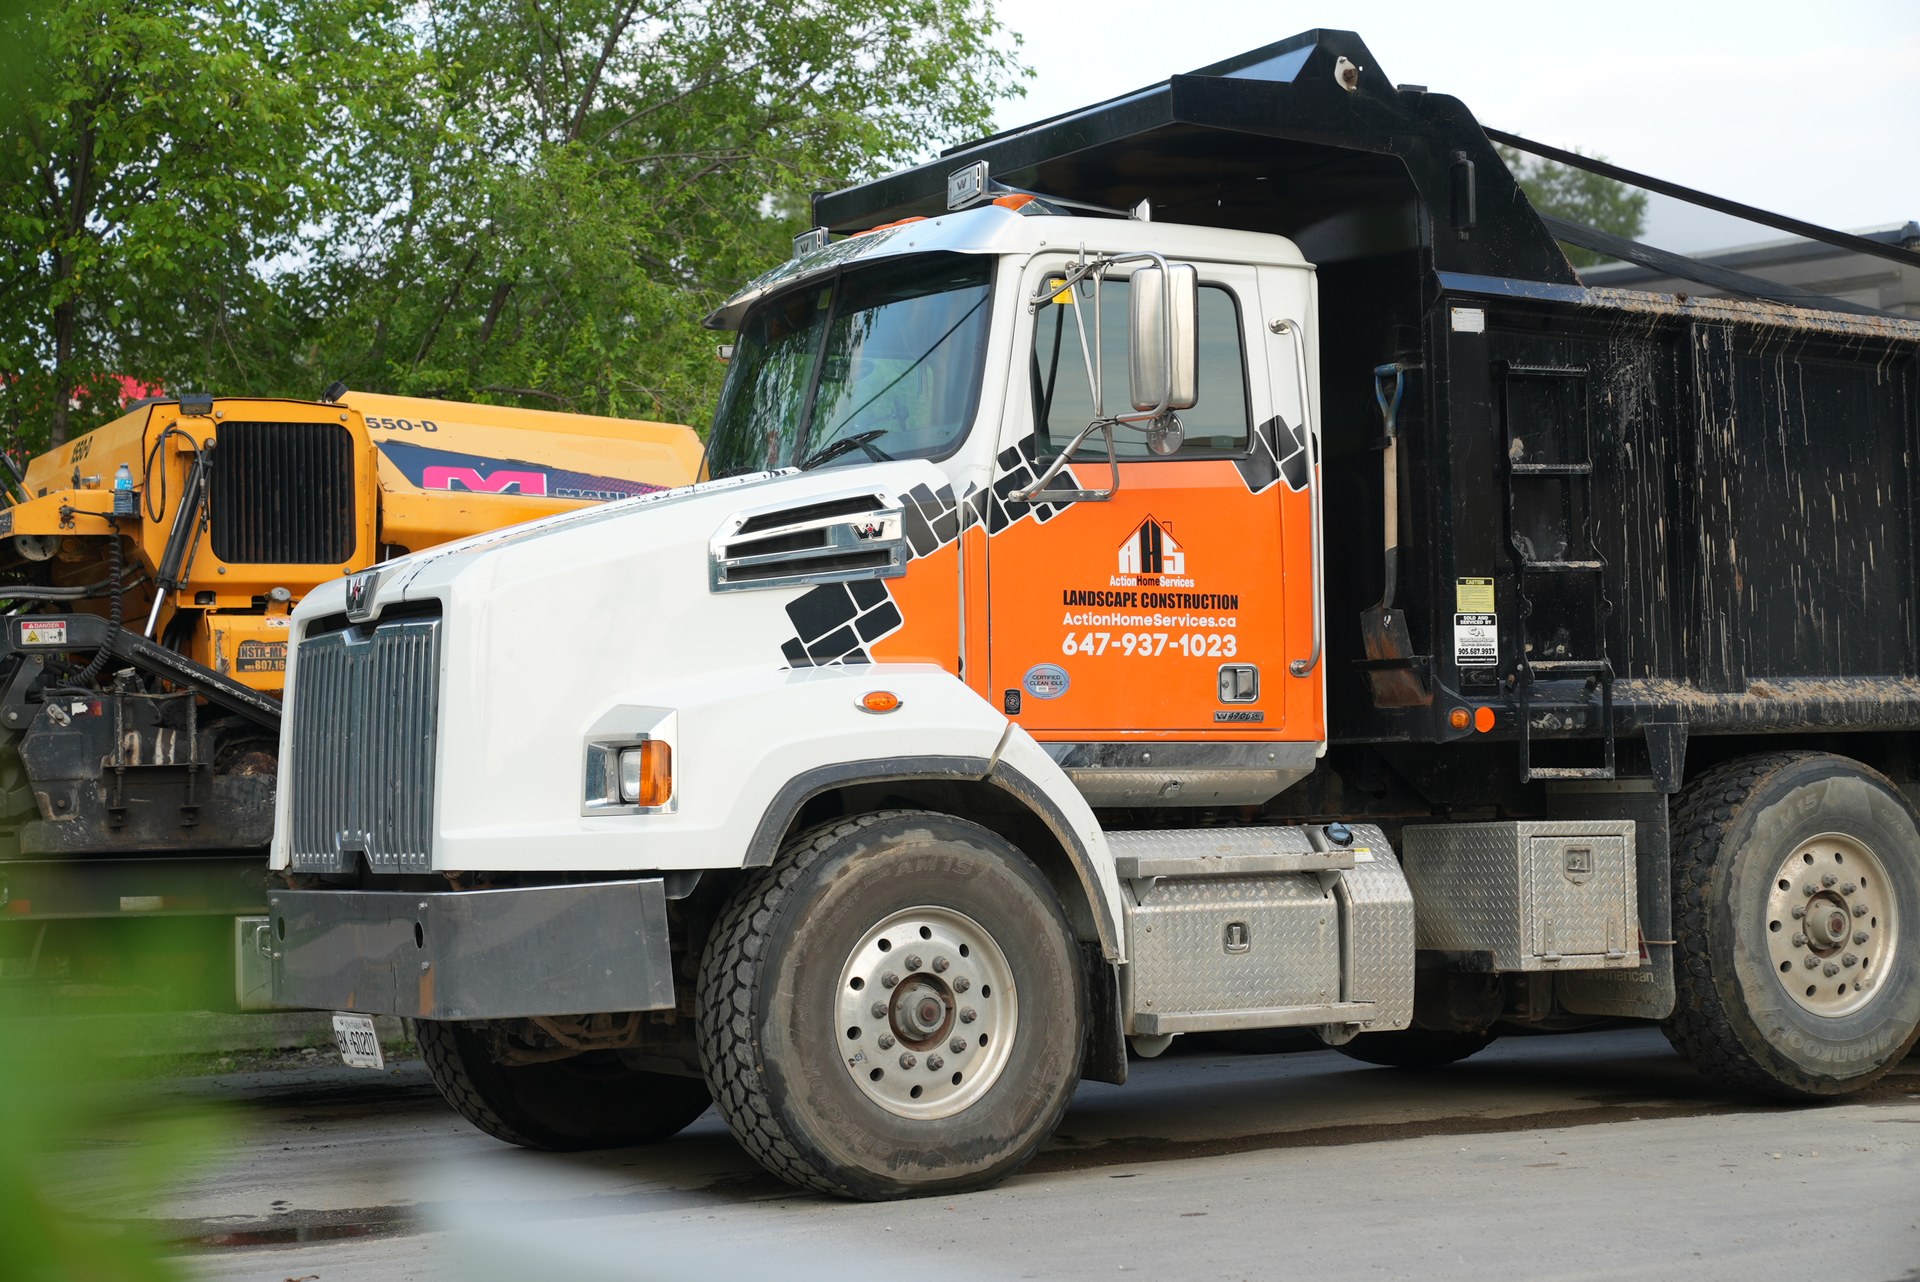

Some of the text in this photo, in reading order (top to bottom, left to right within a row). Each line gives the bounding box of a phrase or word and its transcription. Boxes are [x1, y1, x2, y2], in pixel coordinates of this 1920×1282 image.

[1118, 519, 1185, 575] AHS
[1063, 590, 1239, 610] LANDSCAPE CONSTRUCTION
[1062, 612, 1237, 628] ActionHomeServices.ca
[239, 646, 288, 658] INSTA-MI
[1062, 632, 1238, 657] 647-937-1023
[255, 660, 287, 670] 807.16
